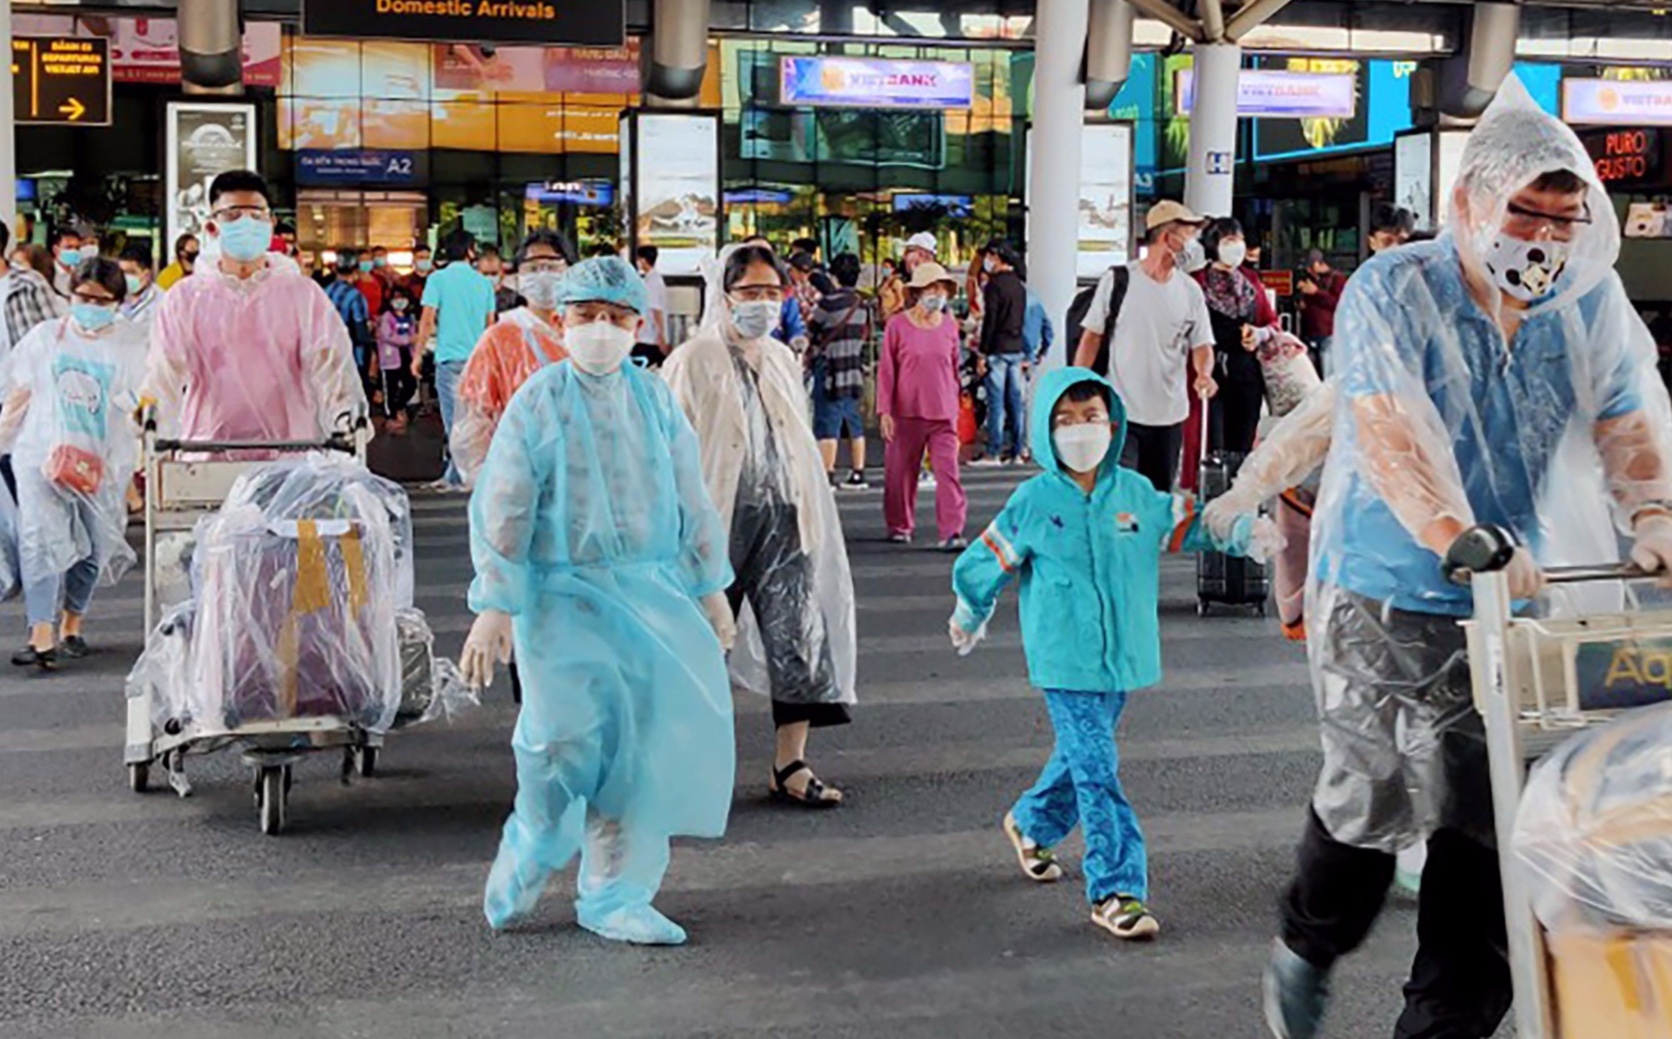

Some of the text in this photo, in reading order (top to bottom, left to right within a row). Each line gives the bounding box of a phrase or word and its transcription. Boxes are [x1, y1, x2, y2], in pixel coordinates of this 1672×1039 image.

[376, 0, 556, 19] Domestic Arrivals
[850, 74, 937, 87] VIETBANK
[1606, 132, 1646, 155] PURO
[386, 158, 412, 174] A2
[1596, 156, 1646, 179] GUSTO
